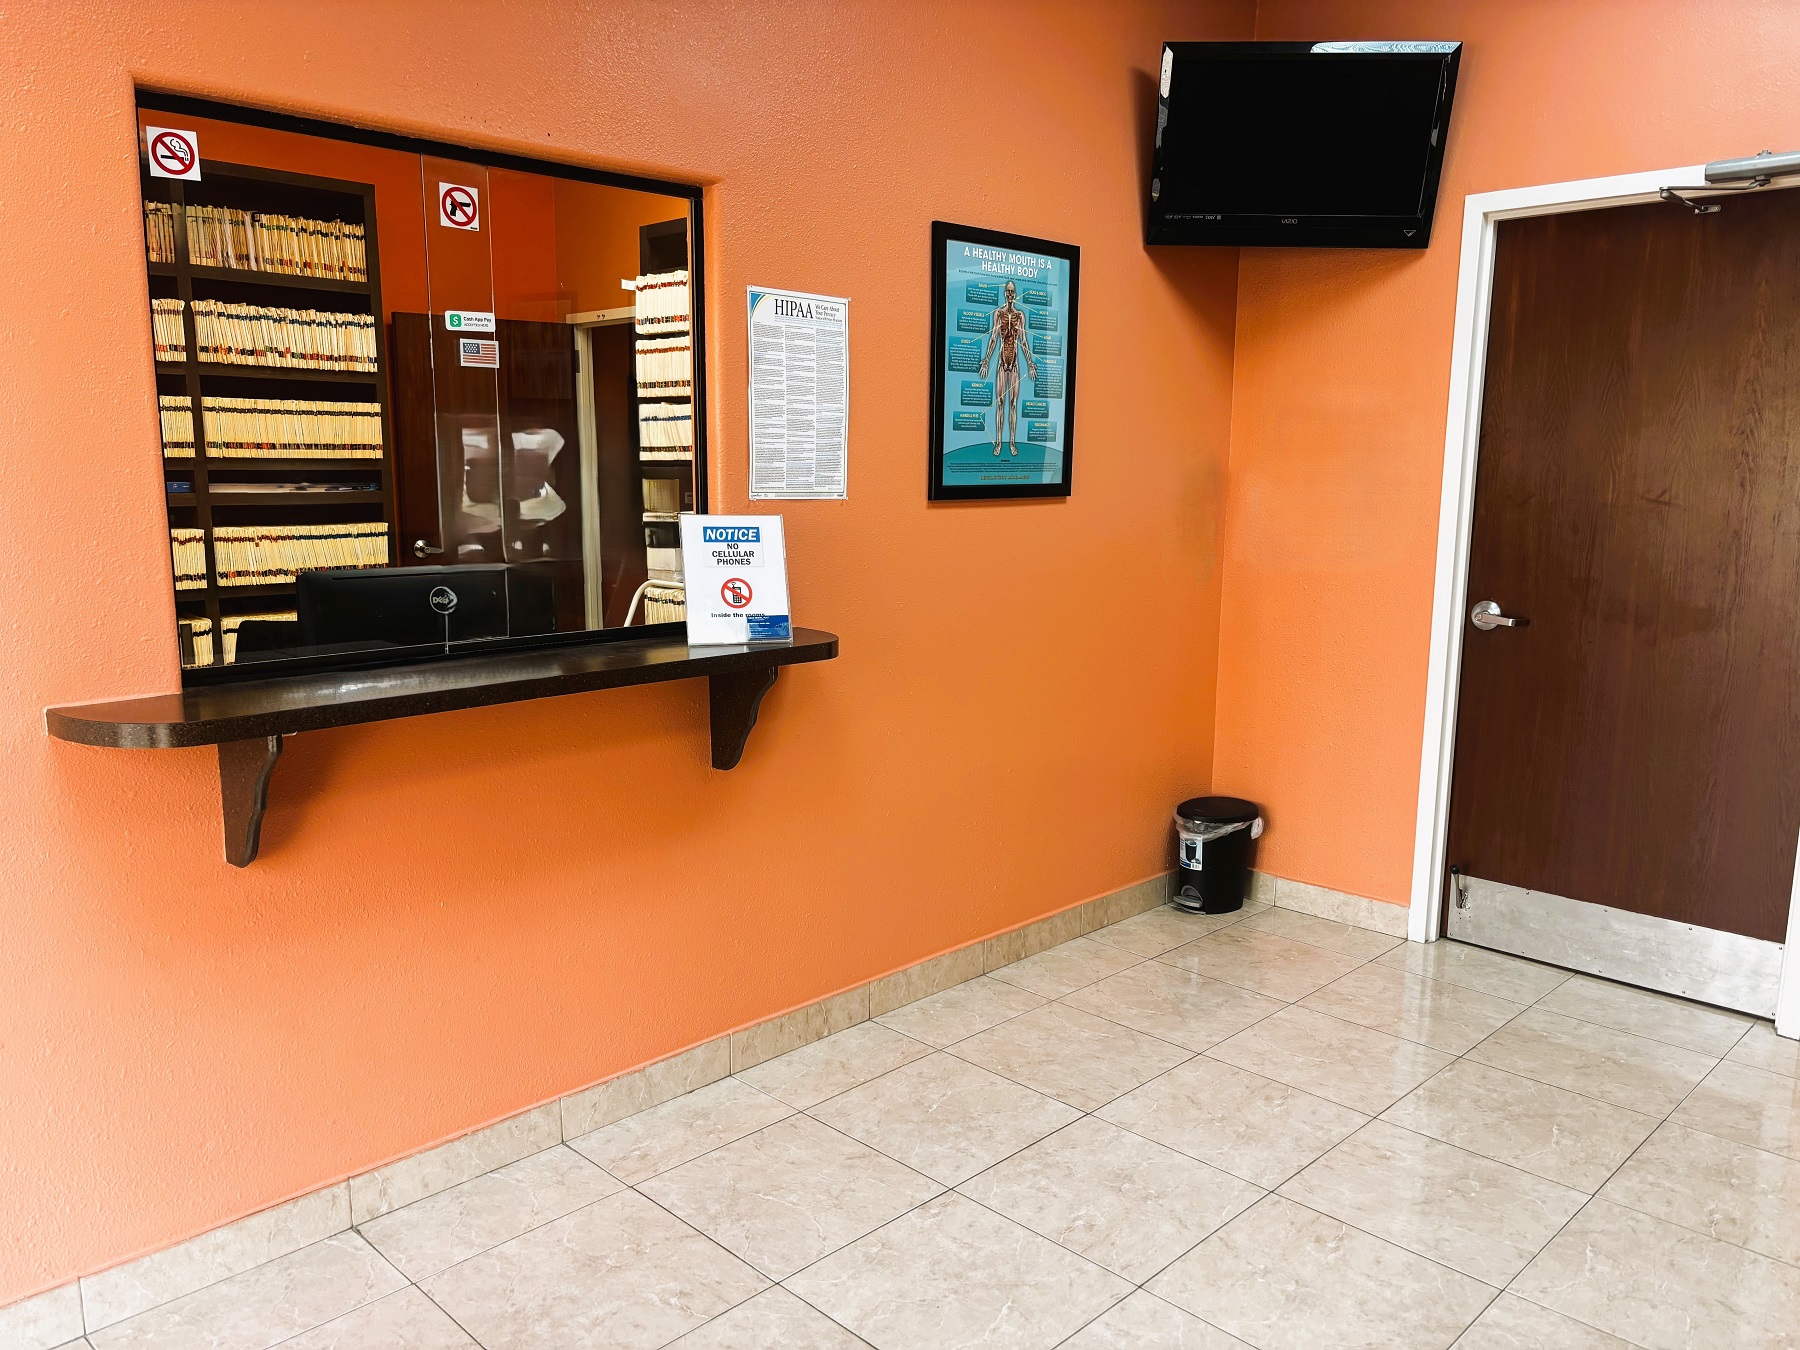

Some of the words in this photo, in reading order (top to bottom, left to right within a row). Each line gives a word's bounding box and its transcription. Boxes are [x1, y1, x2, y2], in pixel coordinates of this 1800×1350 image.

[963, 246, 971, 257] A
[972, 247, 1007, 263] HEALTHY
[1008, 252, 1036, 267] MOUTH
[1038, 258, 1045, 269] IS
[1046, 259, 1052, 270] A
[981, 261, 1017, 276] HEALTHY
[1017, 266, 1039, 279] BODY
[774, 298, 814, 319] HIPAA
[705, 528, 757, 541] NOTICE
[711, 550, 755, 558] CELLULAR
[716, 558, 751, 566] PHONES
